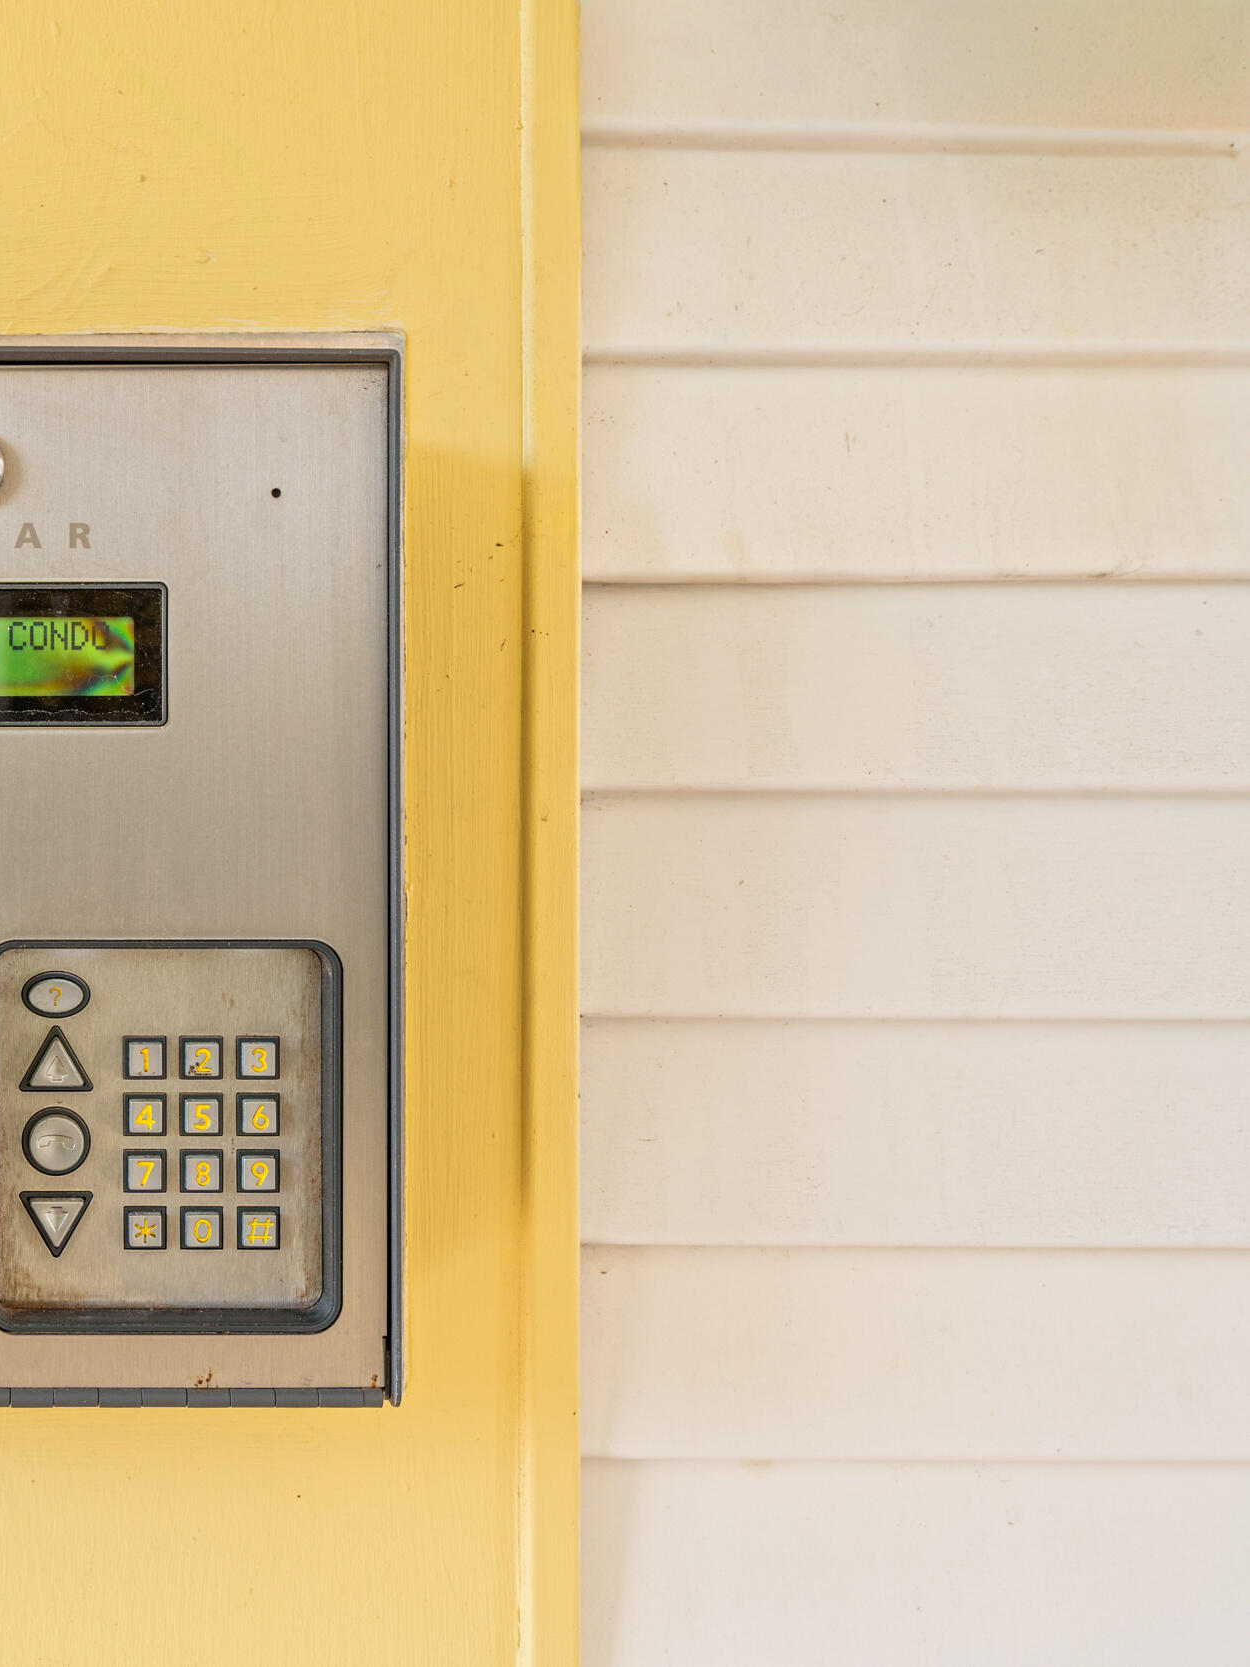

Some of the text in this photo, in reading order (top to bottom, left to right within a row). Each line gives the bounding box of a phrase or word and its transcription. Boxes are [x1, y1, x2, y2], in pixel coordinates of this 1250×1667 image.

[9, 621, 110, 651] CONDO
[49, 987, 62, 1006] ?
[139, 1048, 150, 1073] 1
[196, 1048, 212, 1073] 2
[251, 1048, 267, 1073] 3
[134, 1104, 155, 1130] 4
[193, 1104, 210, 1131] 5
[251, 1104, 269, 1130] 6
[136, 1161, 155, 1187] 7
[195, 1161, 211, 1187] 8
[251, 1161, 269, 1187] 9
[193, 1218, 212, 1243] 0
